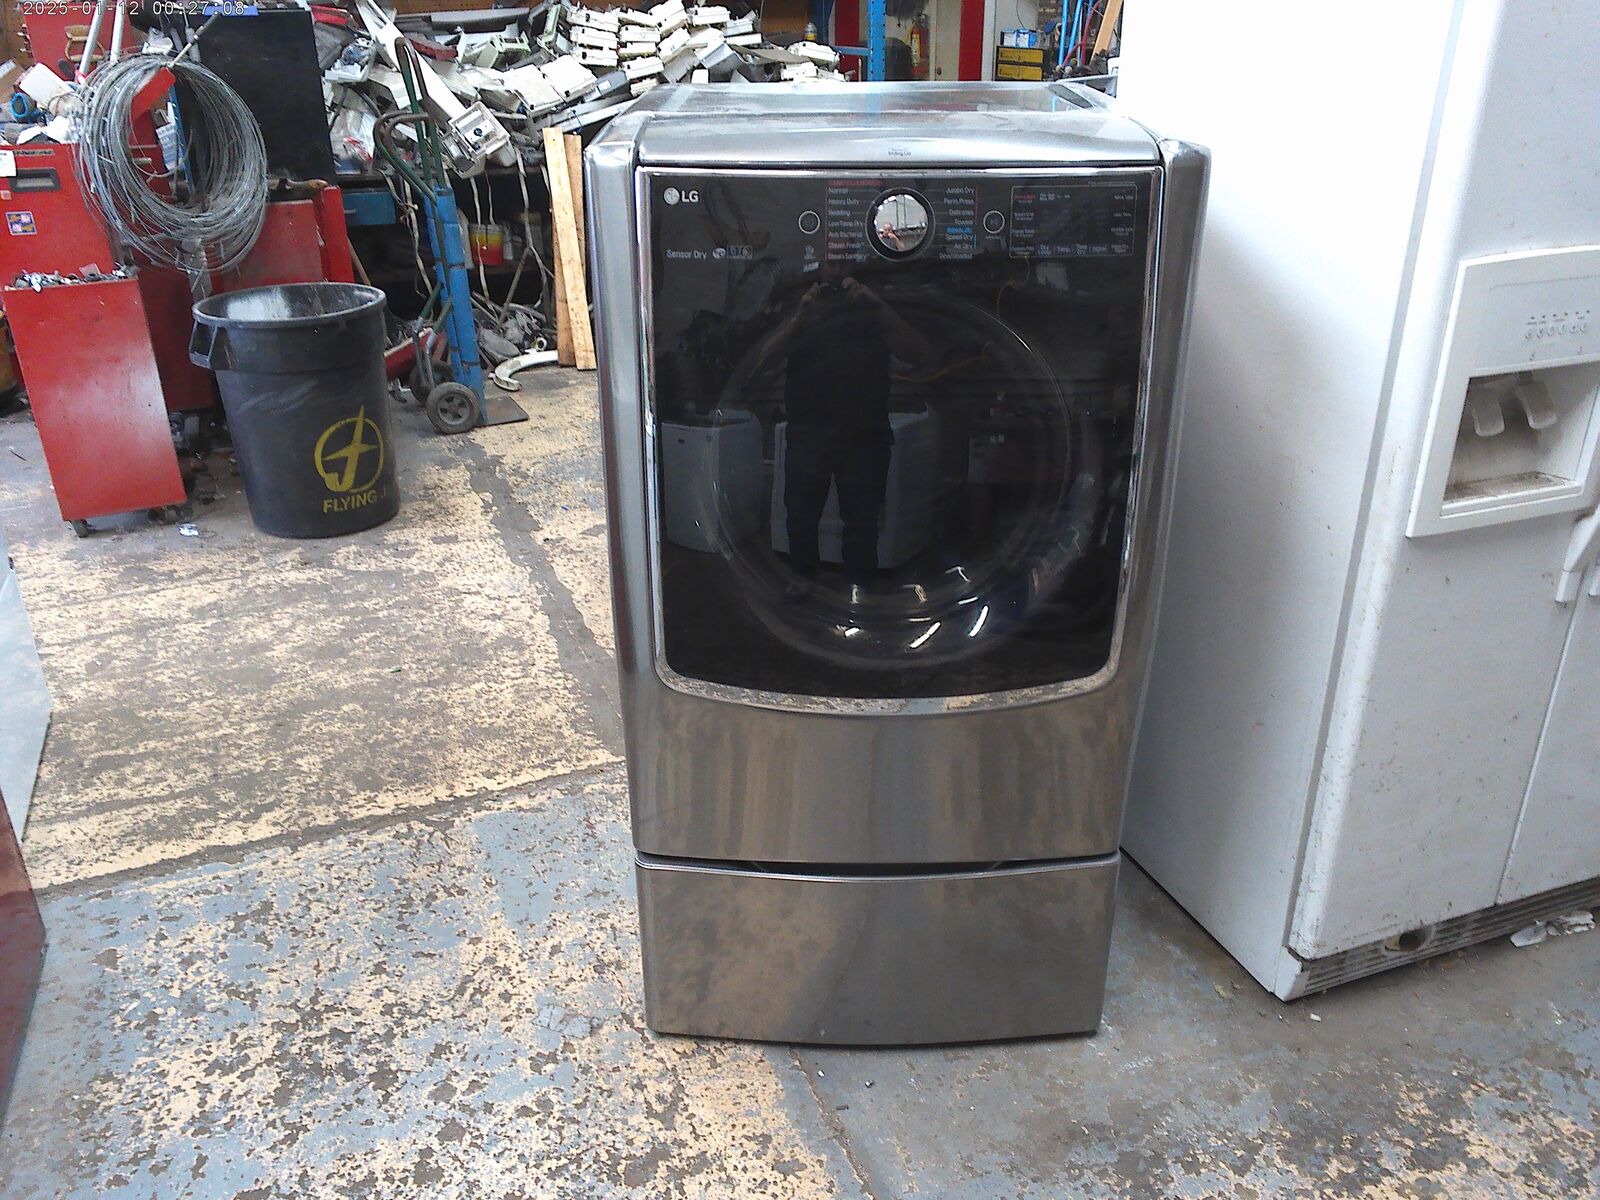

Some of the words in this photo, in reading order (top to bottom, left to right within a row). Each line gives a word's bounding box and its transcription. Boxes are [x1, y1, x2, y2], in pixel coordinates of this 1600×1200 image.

[681, 190, 699, 203] LG
[965, 186, 974, 195] Dry
[666, 249, 691, 259] Sensor
[693, 249, 707, 260] Dry
[322, 489, 378, 513] FLYING
